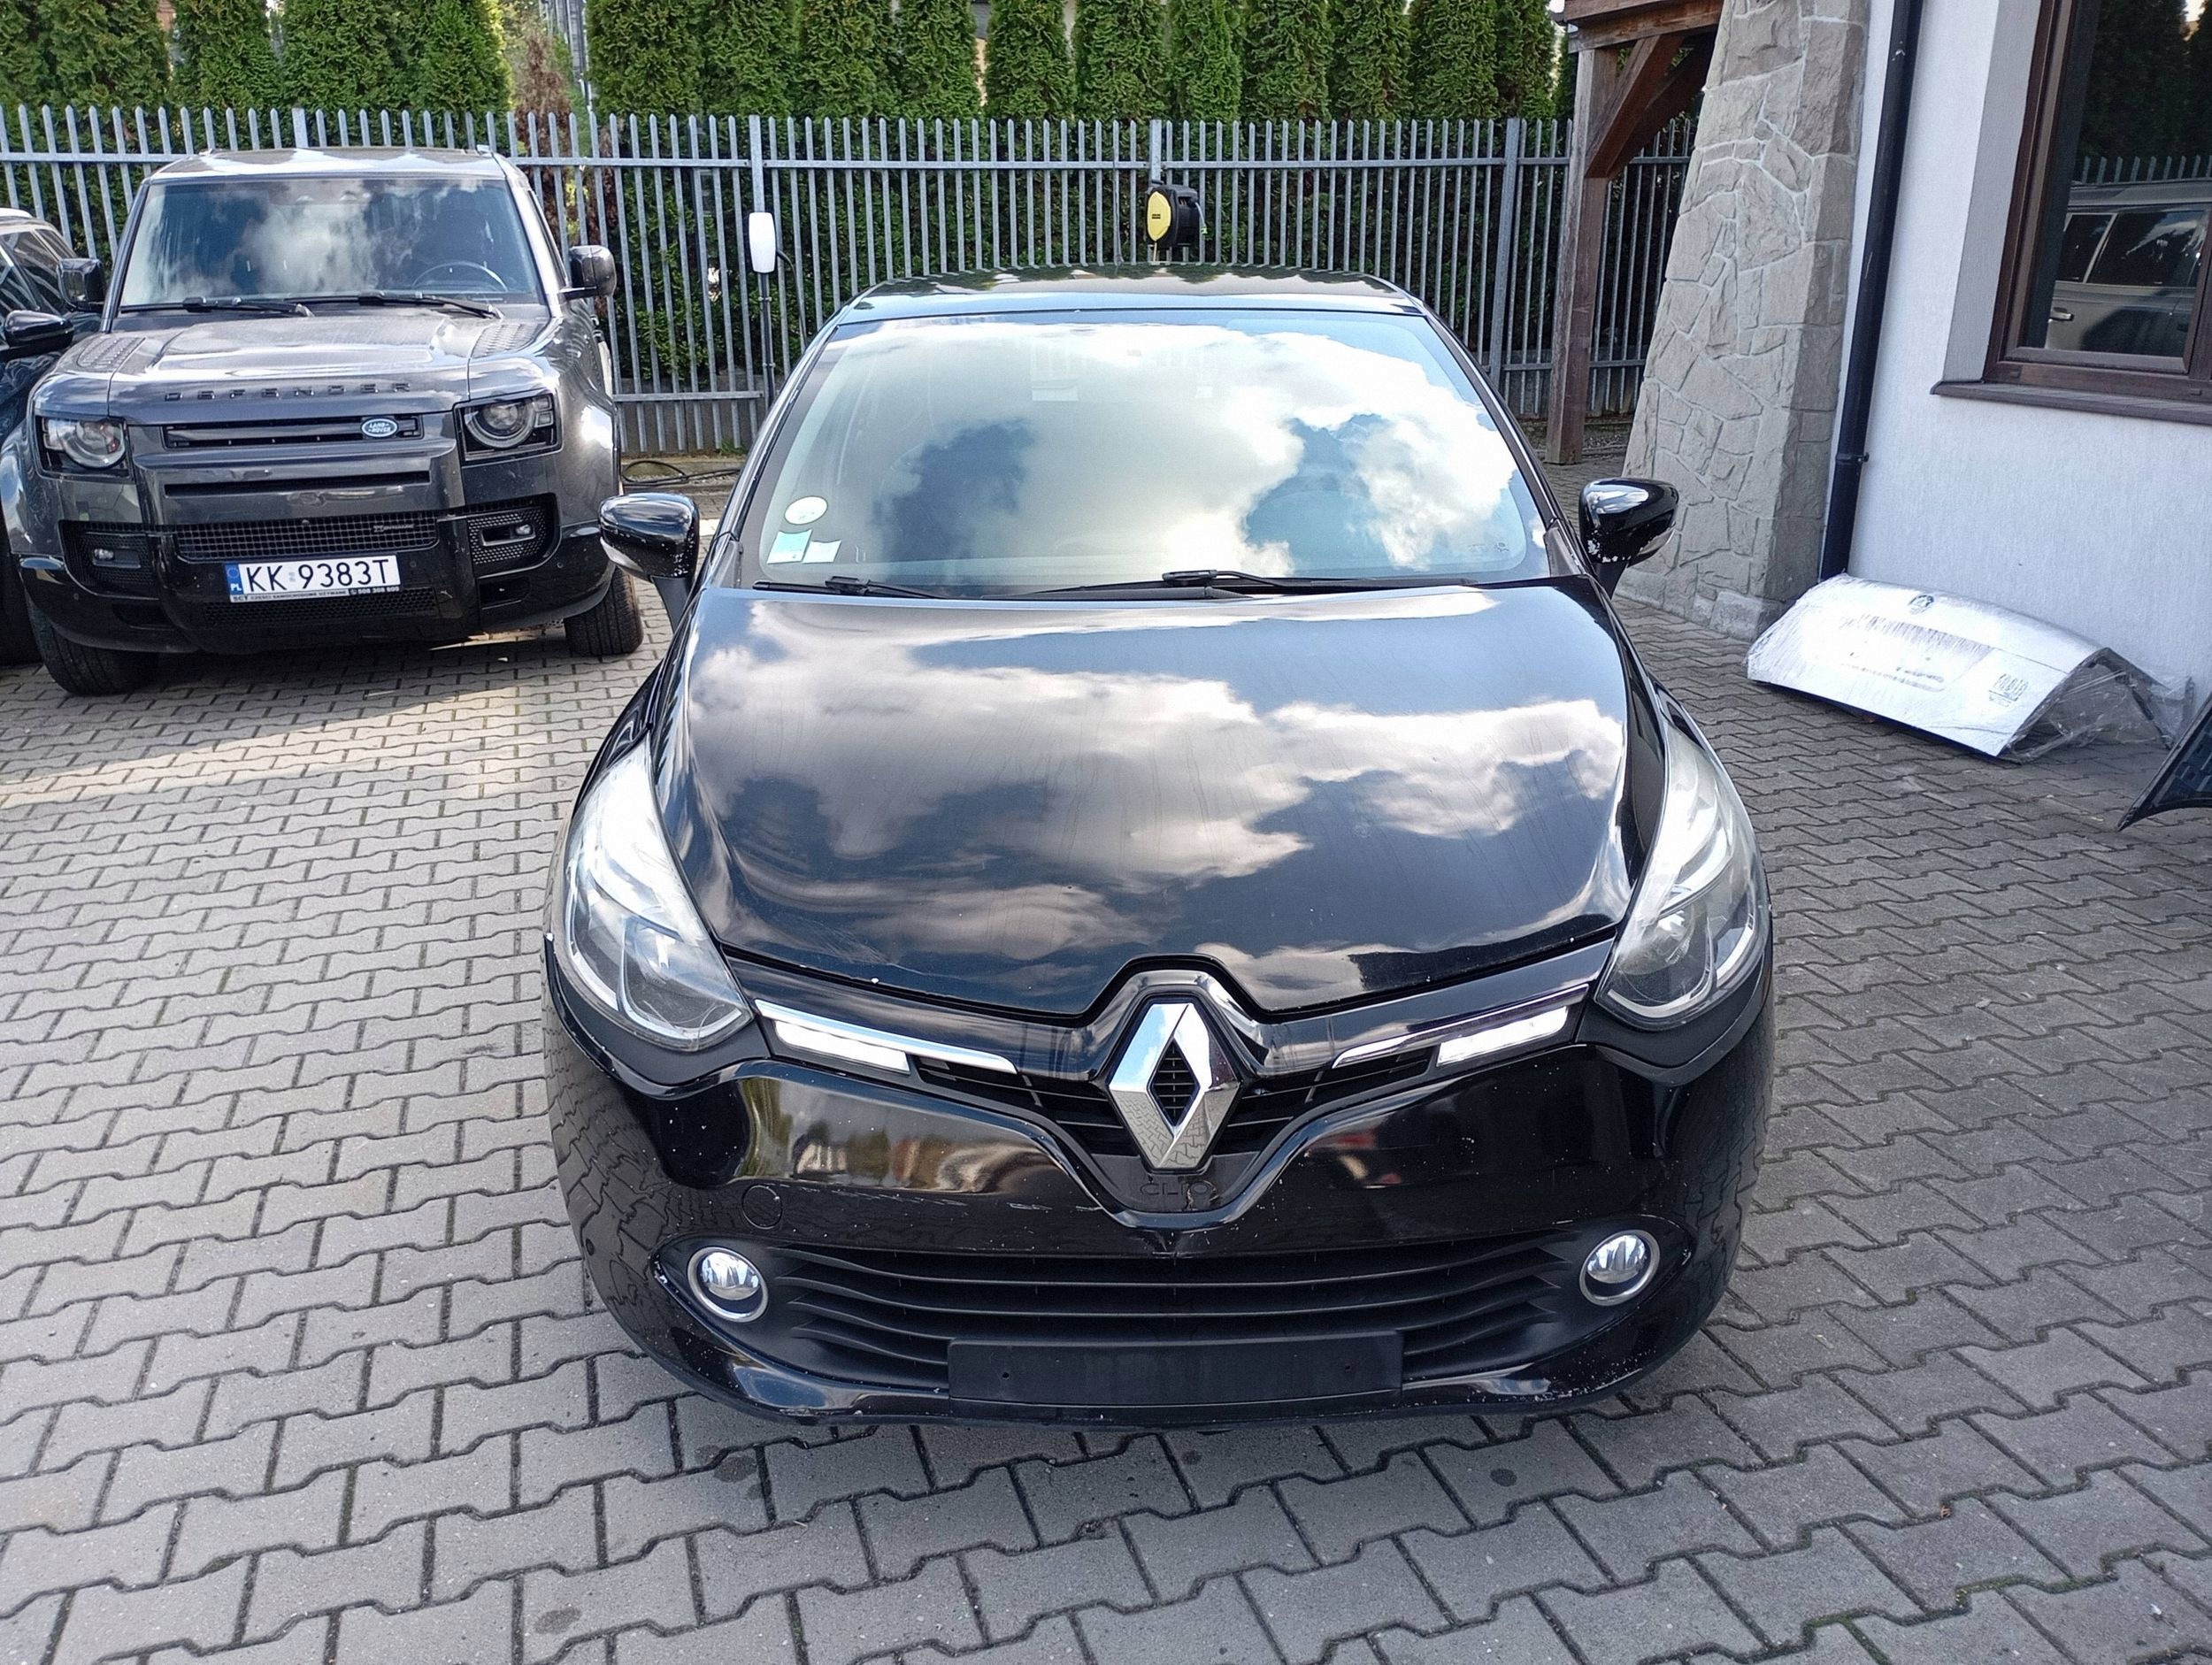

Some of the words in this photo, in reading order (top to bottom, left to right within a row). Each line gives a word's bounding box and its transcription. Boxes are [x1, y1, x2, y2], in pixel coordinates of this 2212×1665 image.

[165, 383, 411, 401] DEFENDER
[246, 565, 288, 592] KK
[297, 559, 389, 589] 9383T
[1140, 1181, 1211, 1196] CLIO
